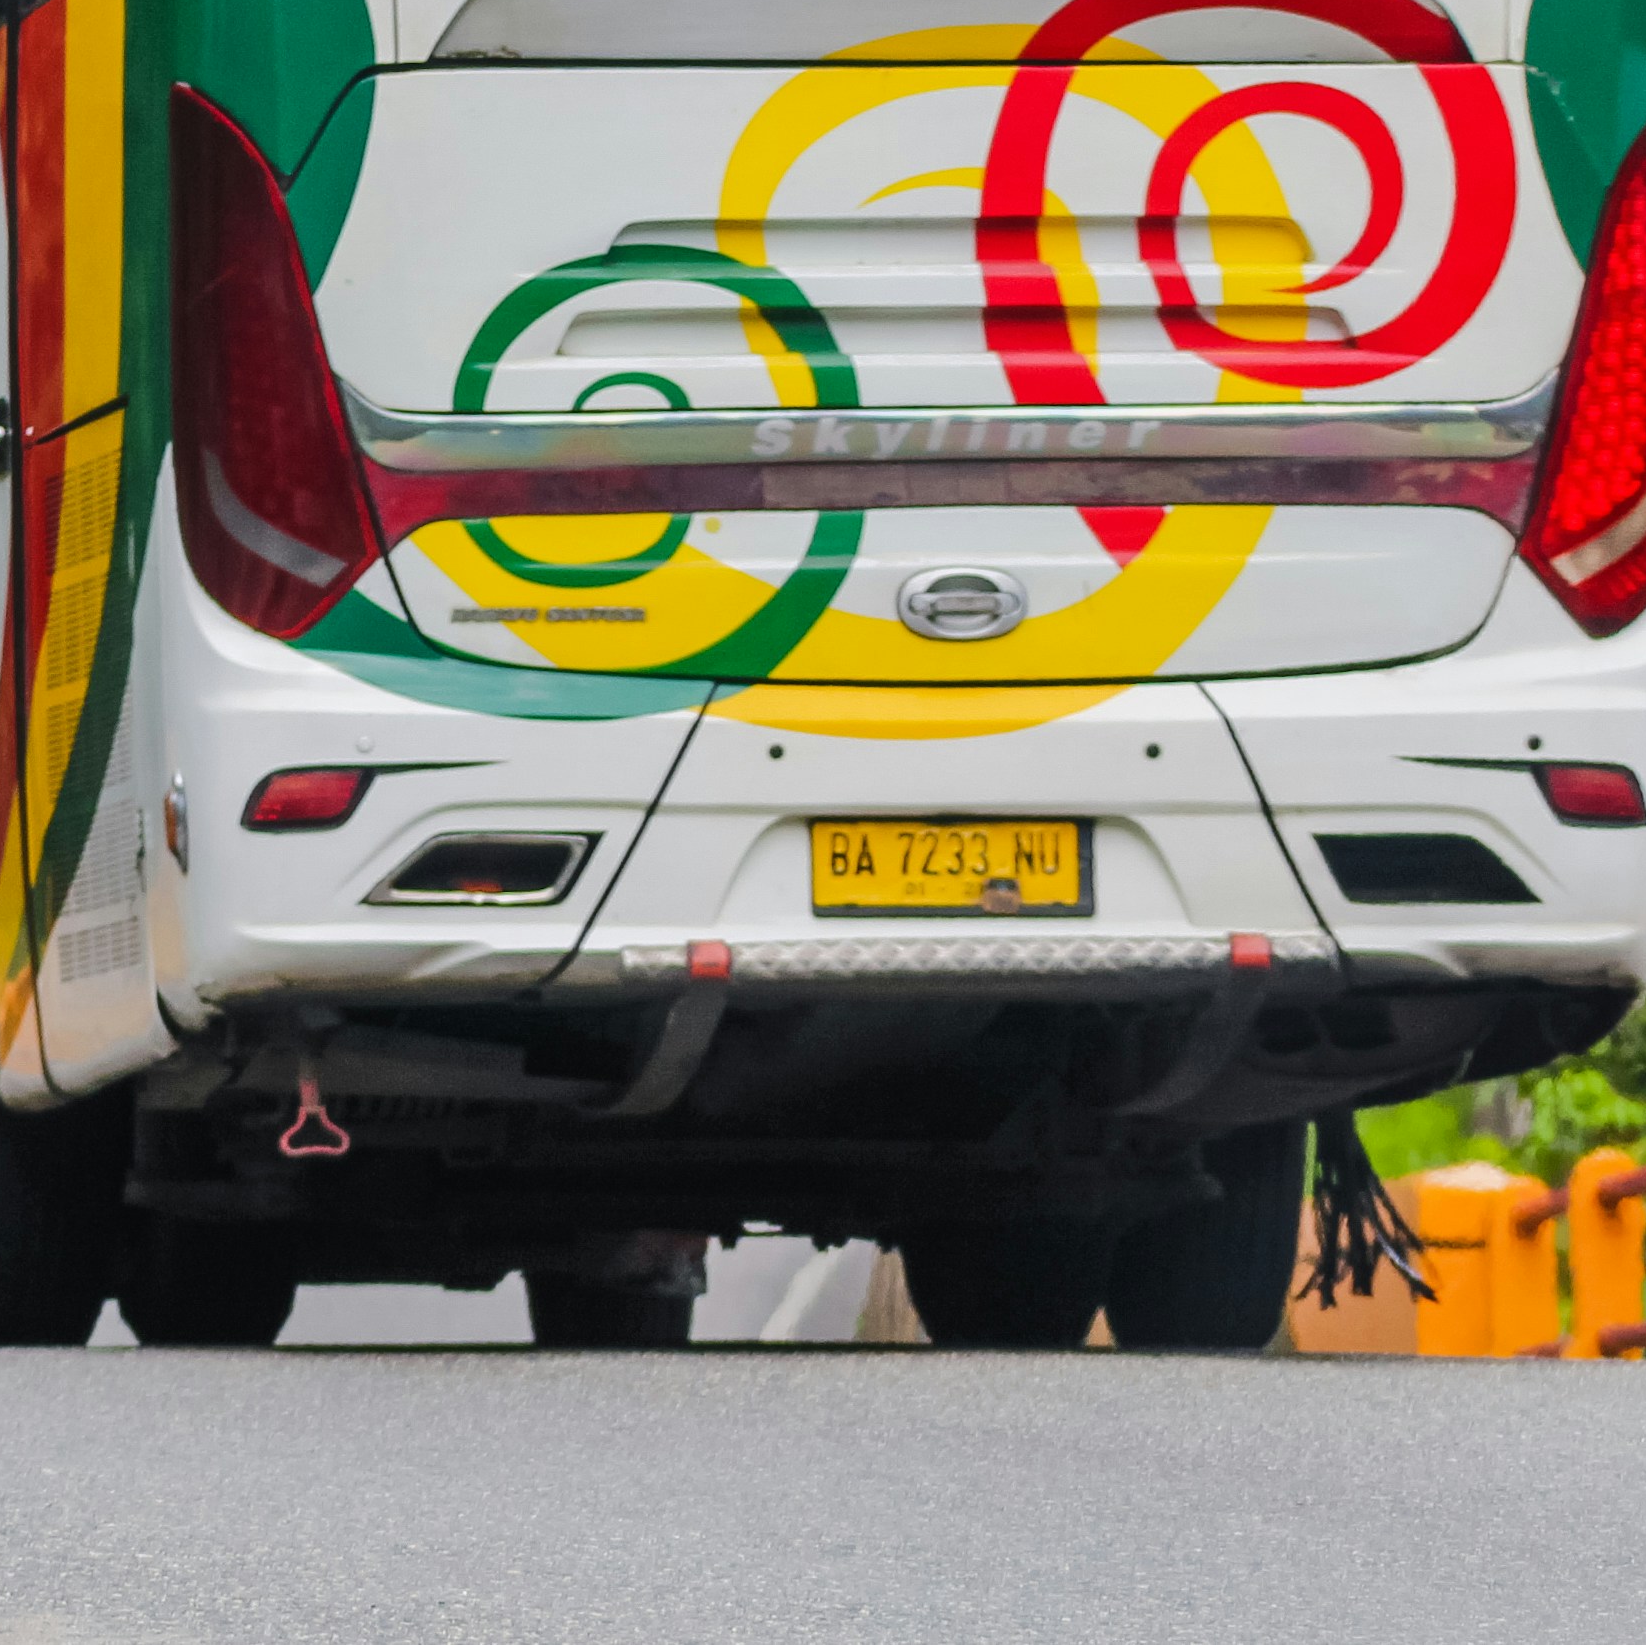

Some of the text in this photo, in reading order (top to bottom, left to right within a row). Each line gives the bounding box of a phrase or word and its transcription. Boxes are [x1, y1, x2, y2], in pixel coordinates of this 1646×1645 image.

[830, 831, 1061, 876] BA 7233 NU
